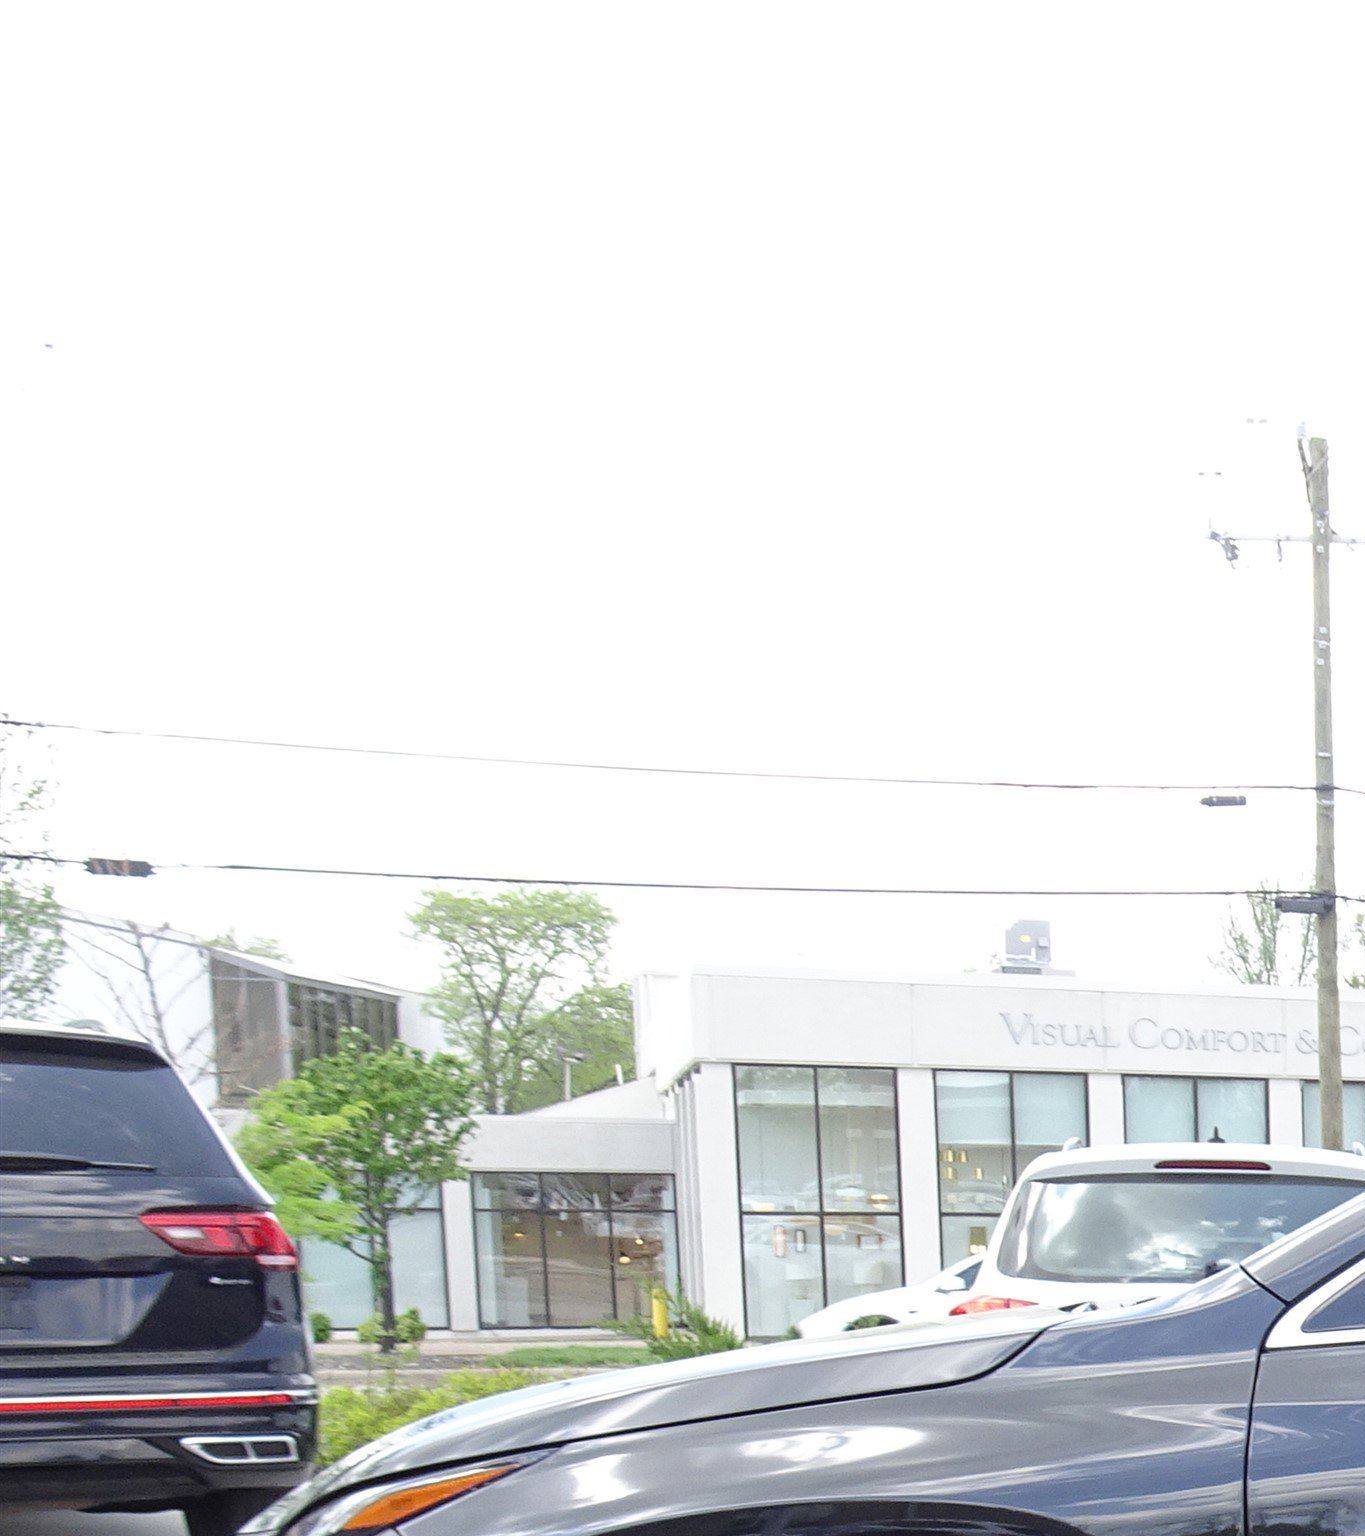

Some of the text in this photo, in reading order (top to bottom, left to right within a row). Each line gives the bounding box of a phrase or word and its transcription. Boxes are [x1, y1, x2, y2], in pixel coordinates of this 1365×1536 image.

[999, 1012, 1119, 1049] VISUAL
[1128, 1017, 1287, 1054] COMFORT
[1295, 1028, 1319, 1055] &
